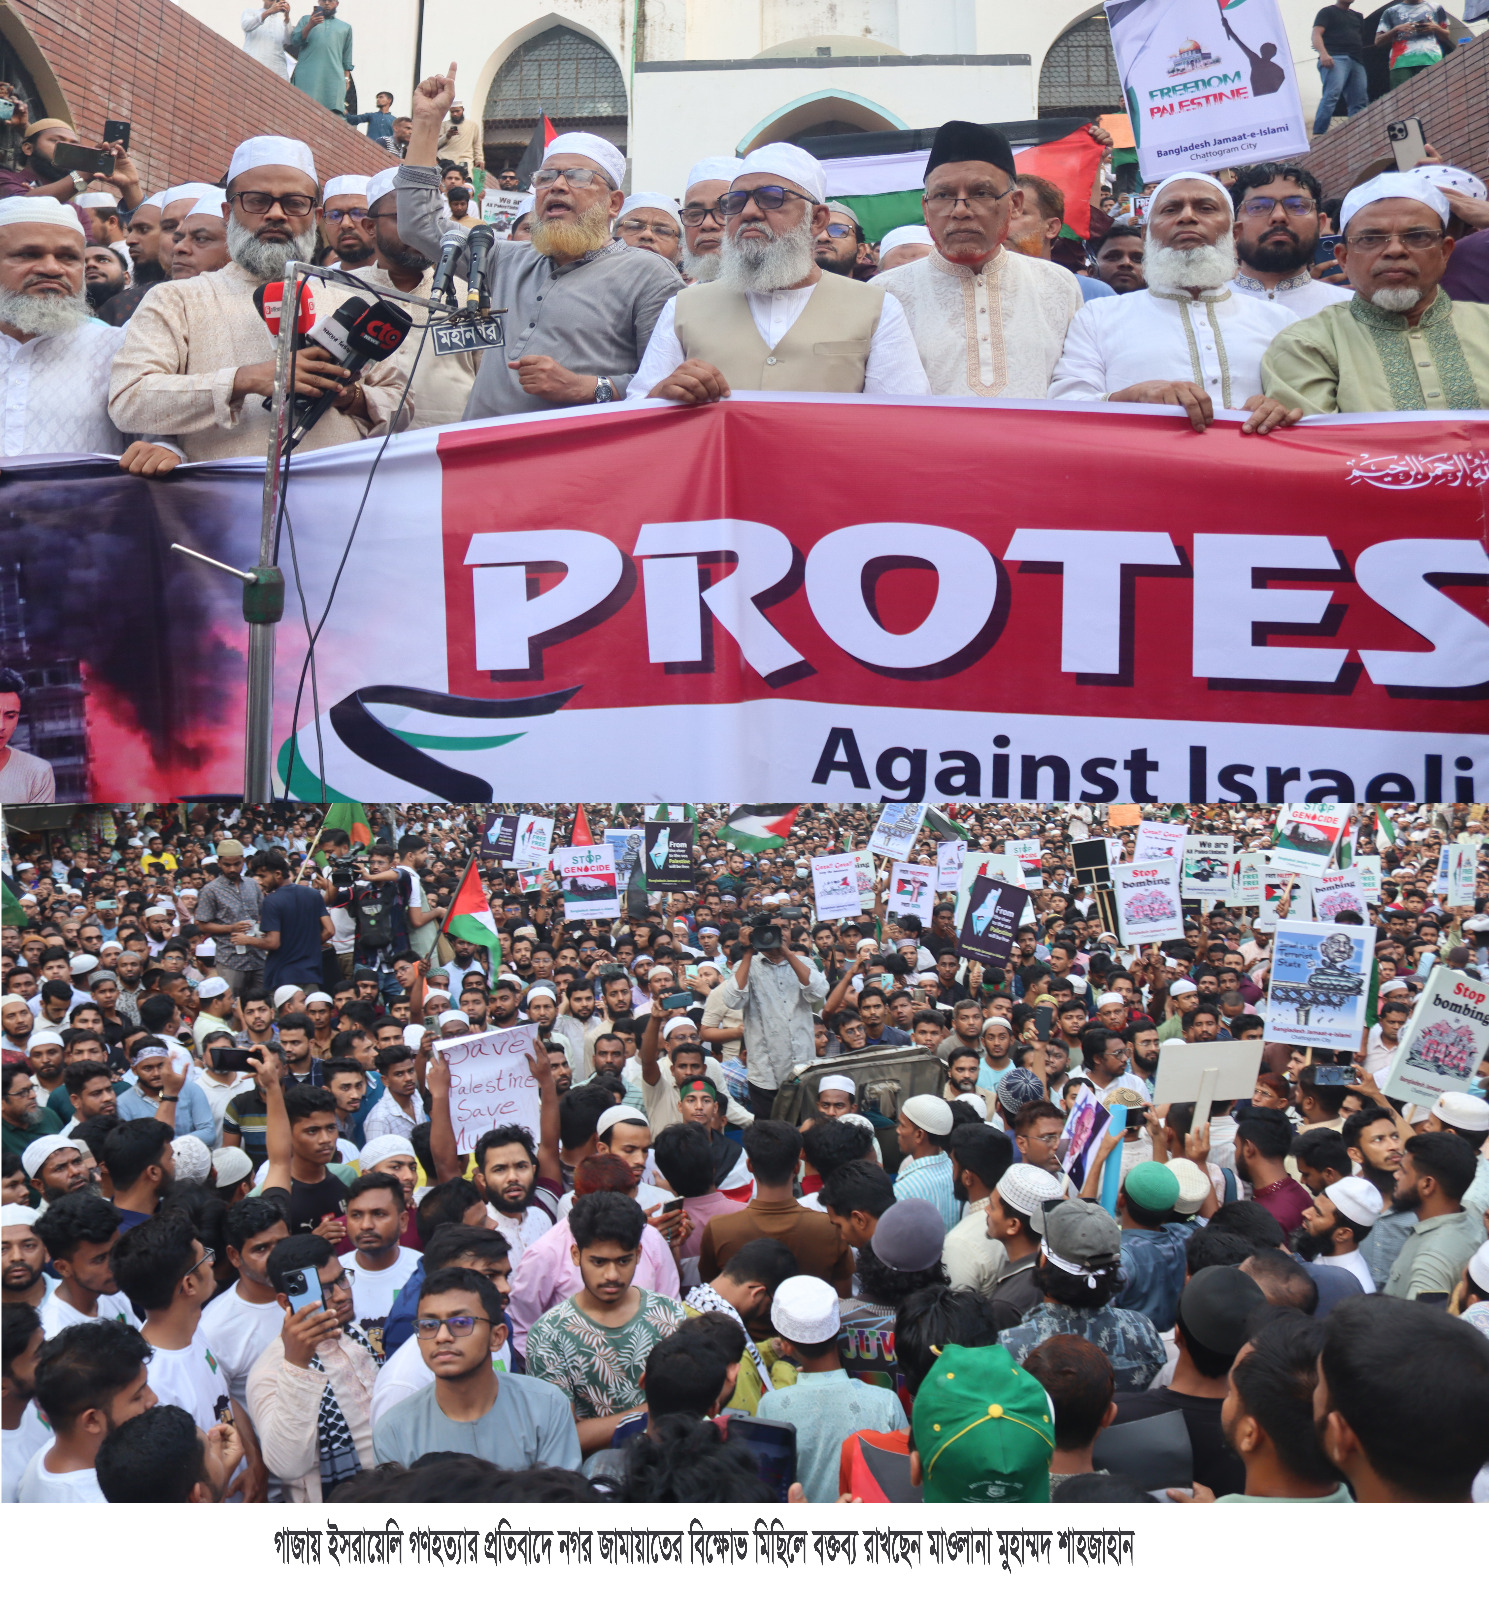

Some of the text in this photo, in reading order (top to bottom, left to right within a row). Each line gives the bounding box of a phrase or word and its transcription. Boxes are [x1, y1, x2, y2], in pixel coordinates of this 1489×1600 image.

[1149, 71, 1242, 101] FREEDOM
[1149, 87, 1250, 119] PALESTINE
[1156, 123, 1289, 158] Bangladesh Jamaat-e-Islami
[1189, 142, 1258, 161] Chattogram City
[811, 726, 1475, 803] Against Israeli
[1292, 811, 1339, 824] GENOCIDE
[571, 854, 602, 864] STOP
[1132, 869, 1158, 877] Stop
[1322, 875, 1344, 883] Stop
[1121, 878, 1171, 888] bombing
[1315, 881, 1356, 893] bombing
[995, 905, 1015, 918] From
[1278, 948, 1314, 960] Terrorist
[1277, 958, 1301, 968] State
[1453, 982, 1486, 1005] Stop
[1433, 993, 1489, 1026] bombing
[1273, 1026, 1305, 1034] Bangladesh
[443, 1039, 528, 1066] Save
[449, 1069, 538, 1098] Palestine
[457, 1098, 519, 1122] Save
